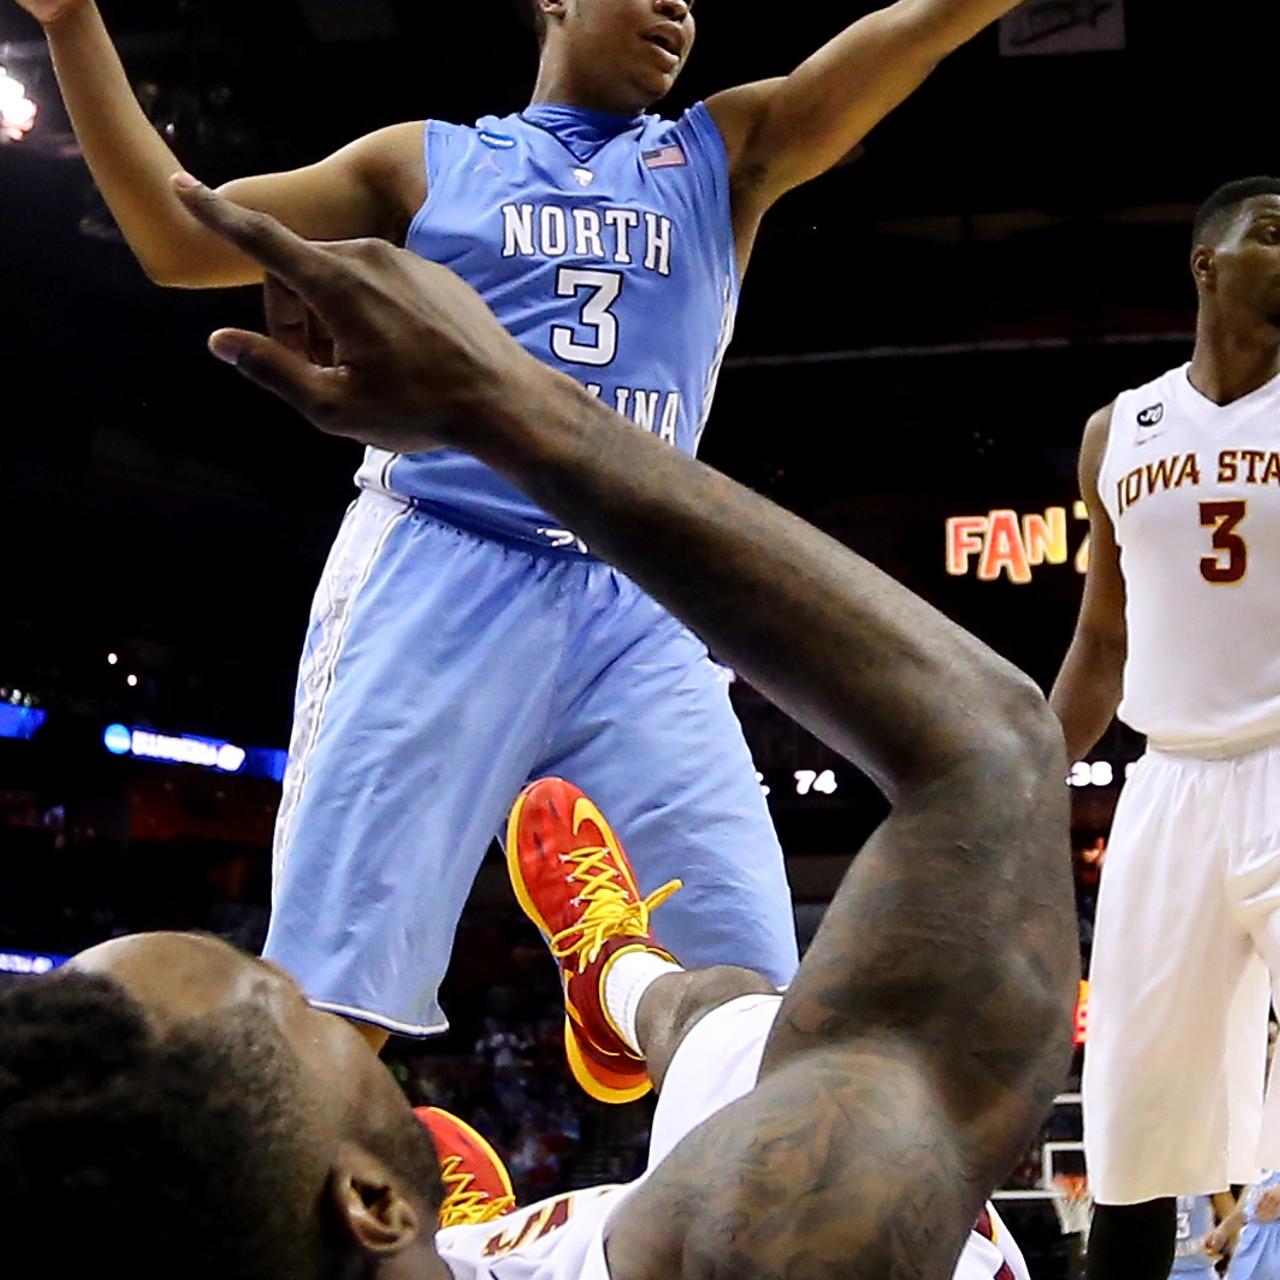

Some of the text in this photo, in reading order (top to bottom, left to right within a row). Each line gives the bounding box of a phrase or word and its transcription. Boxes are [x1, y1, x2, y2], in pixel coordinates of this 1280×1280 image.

[501, 203, 672, 277] NORTH
[549, 265, 624, 367] 3
[1117, 452, 1201, 516] IOWA
[945, 506, 1068, 584] FAN
[1197, 499, 1248, 584] 3
